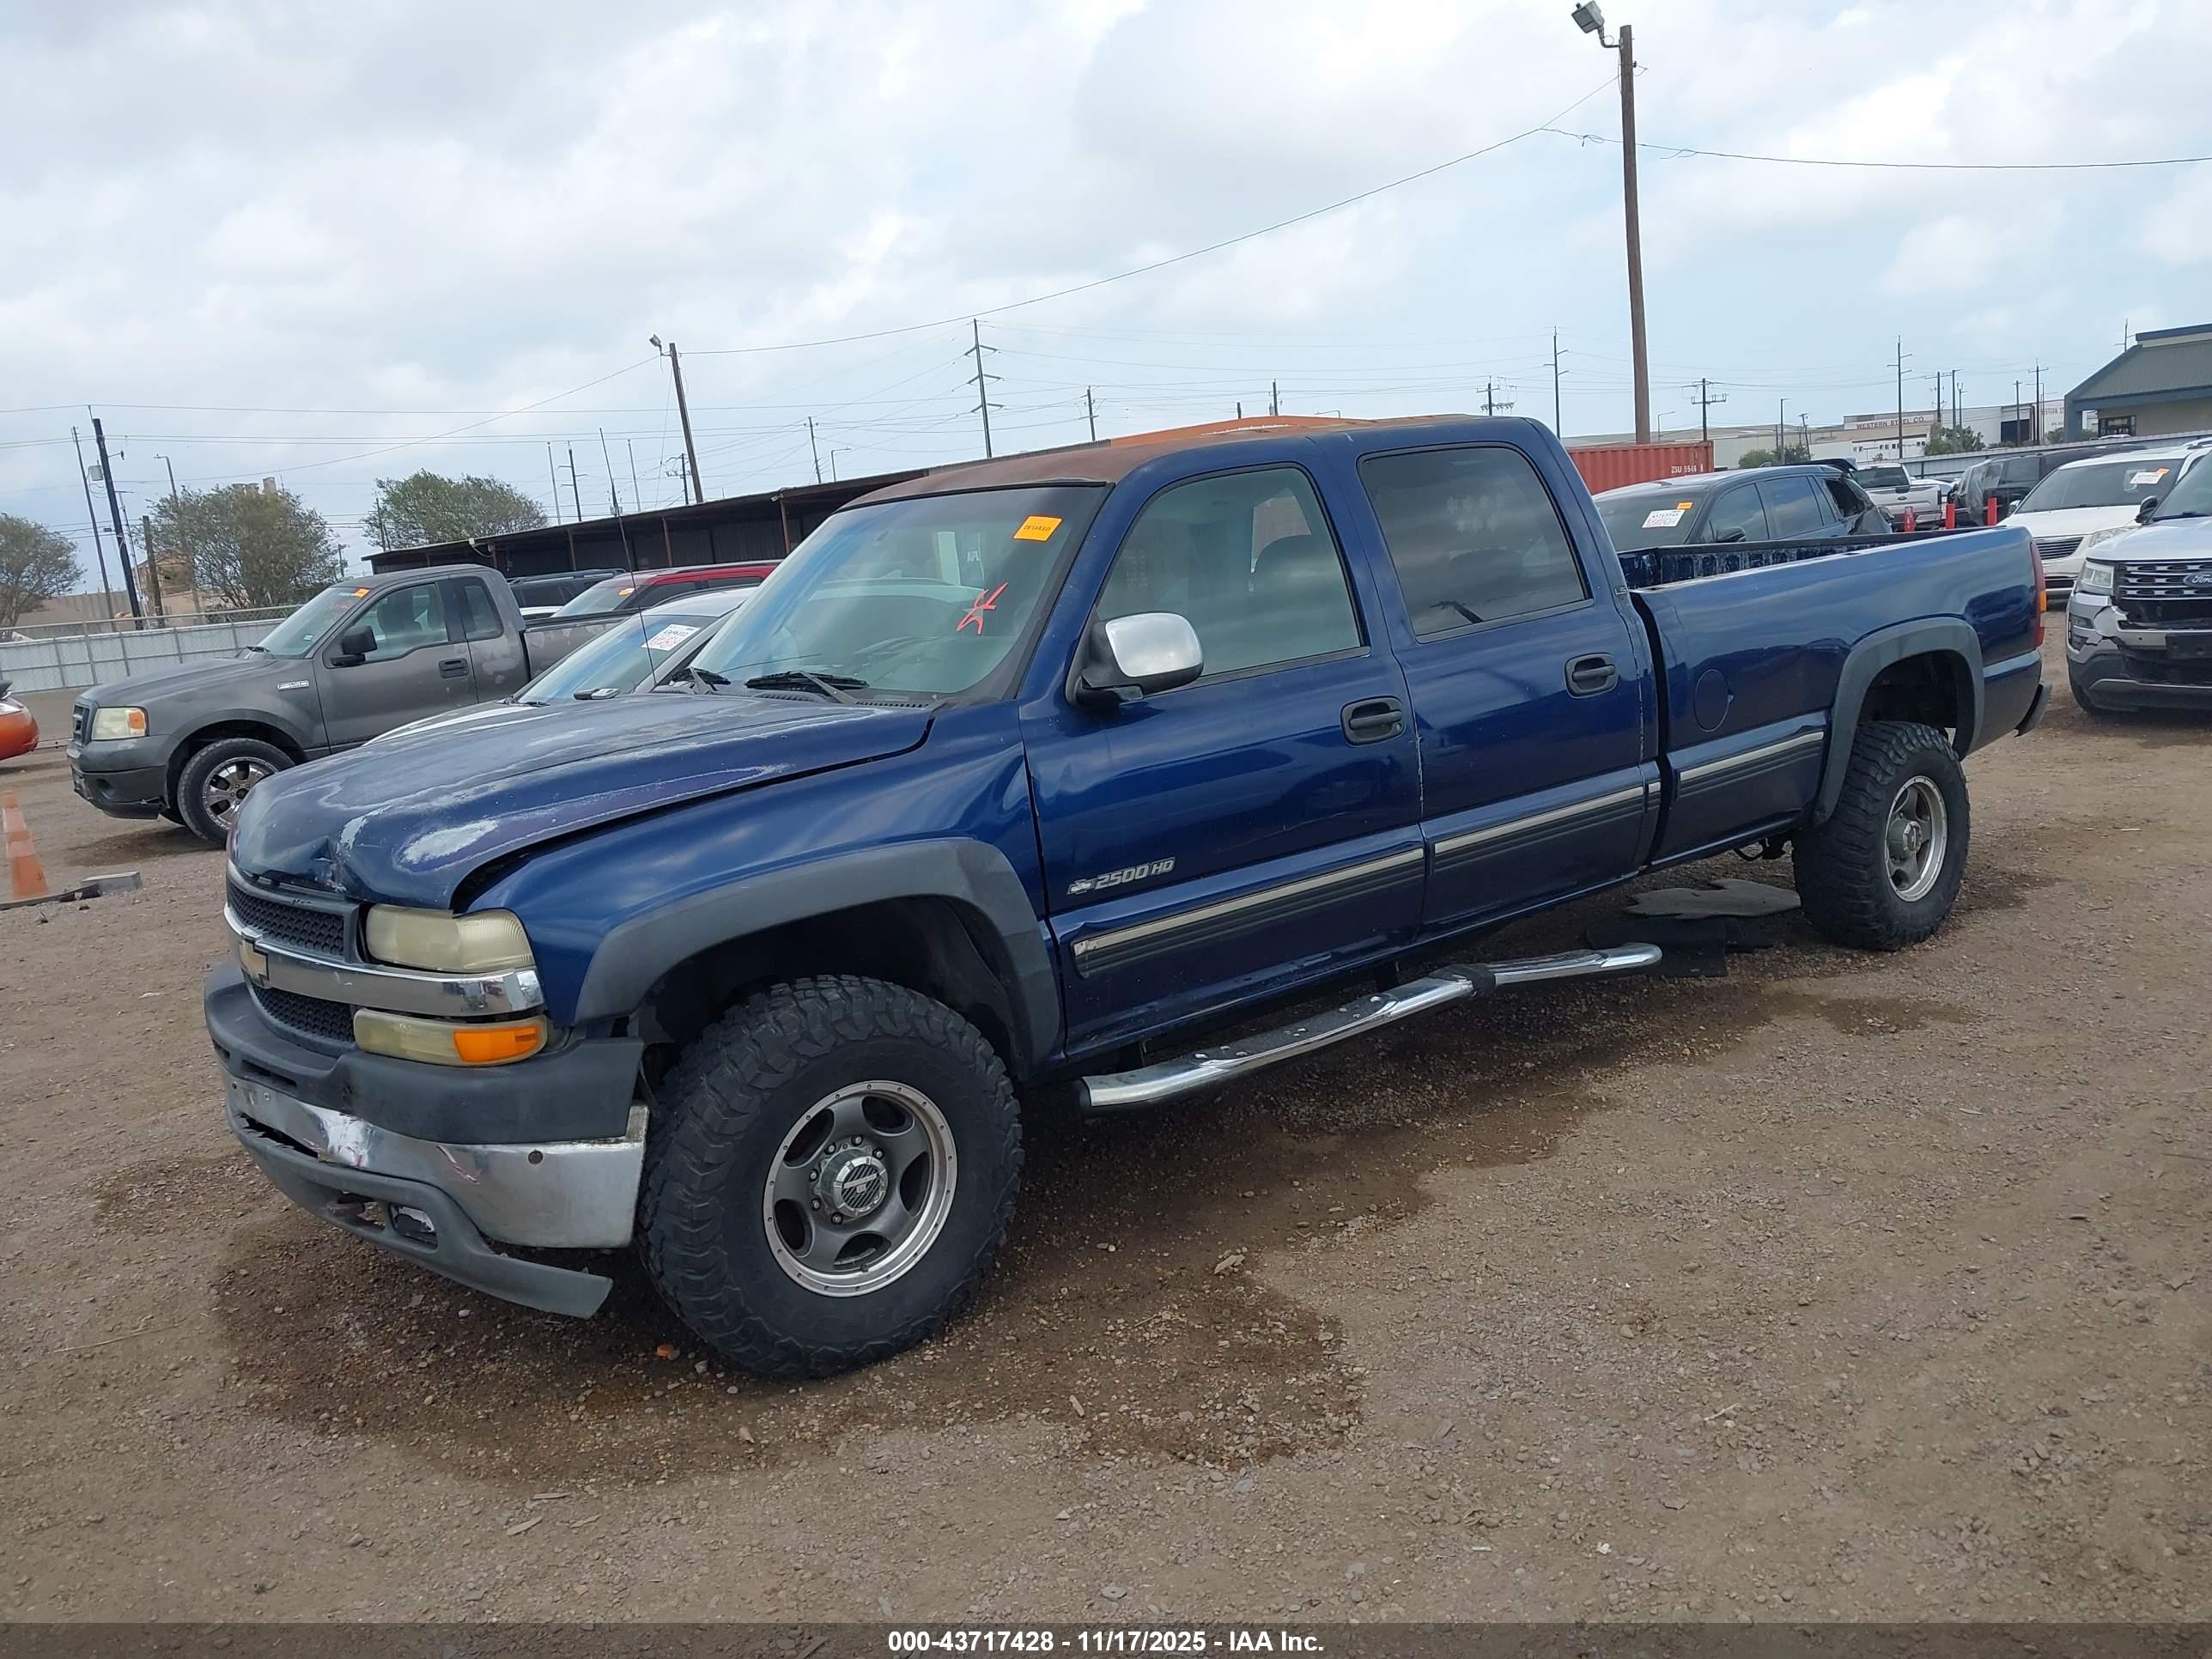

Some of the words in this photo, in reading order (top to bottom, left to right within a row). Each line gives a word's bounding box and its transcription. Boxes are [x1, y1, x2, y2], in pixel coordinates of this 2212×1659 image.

[1856, 420, 1888, 430] WESTERN
[1891, 417, 1911, 427] STEL
[1095, 864, 1150, 890] 2500
[1152, 859, 1175, 875] HD
